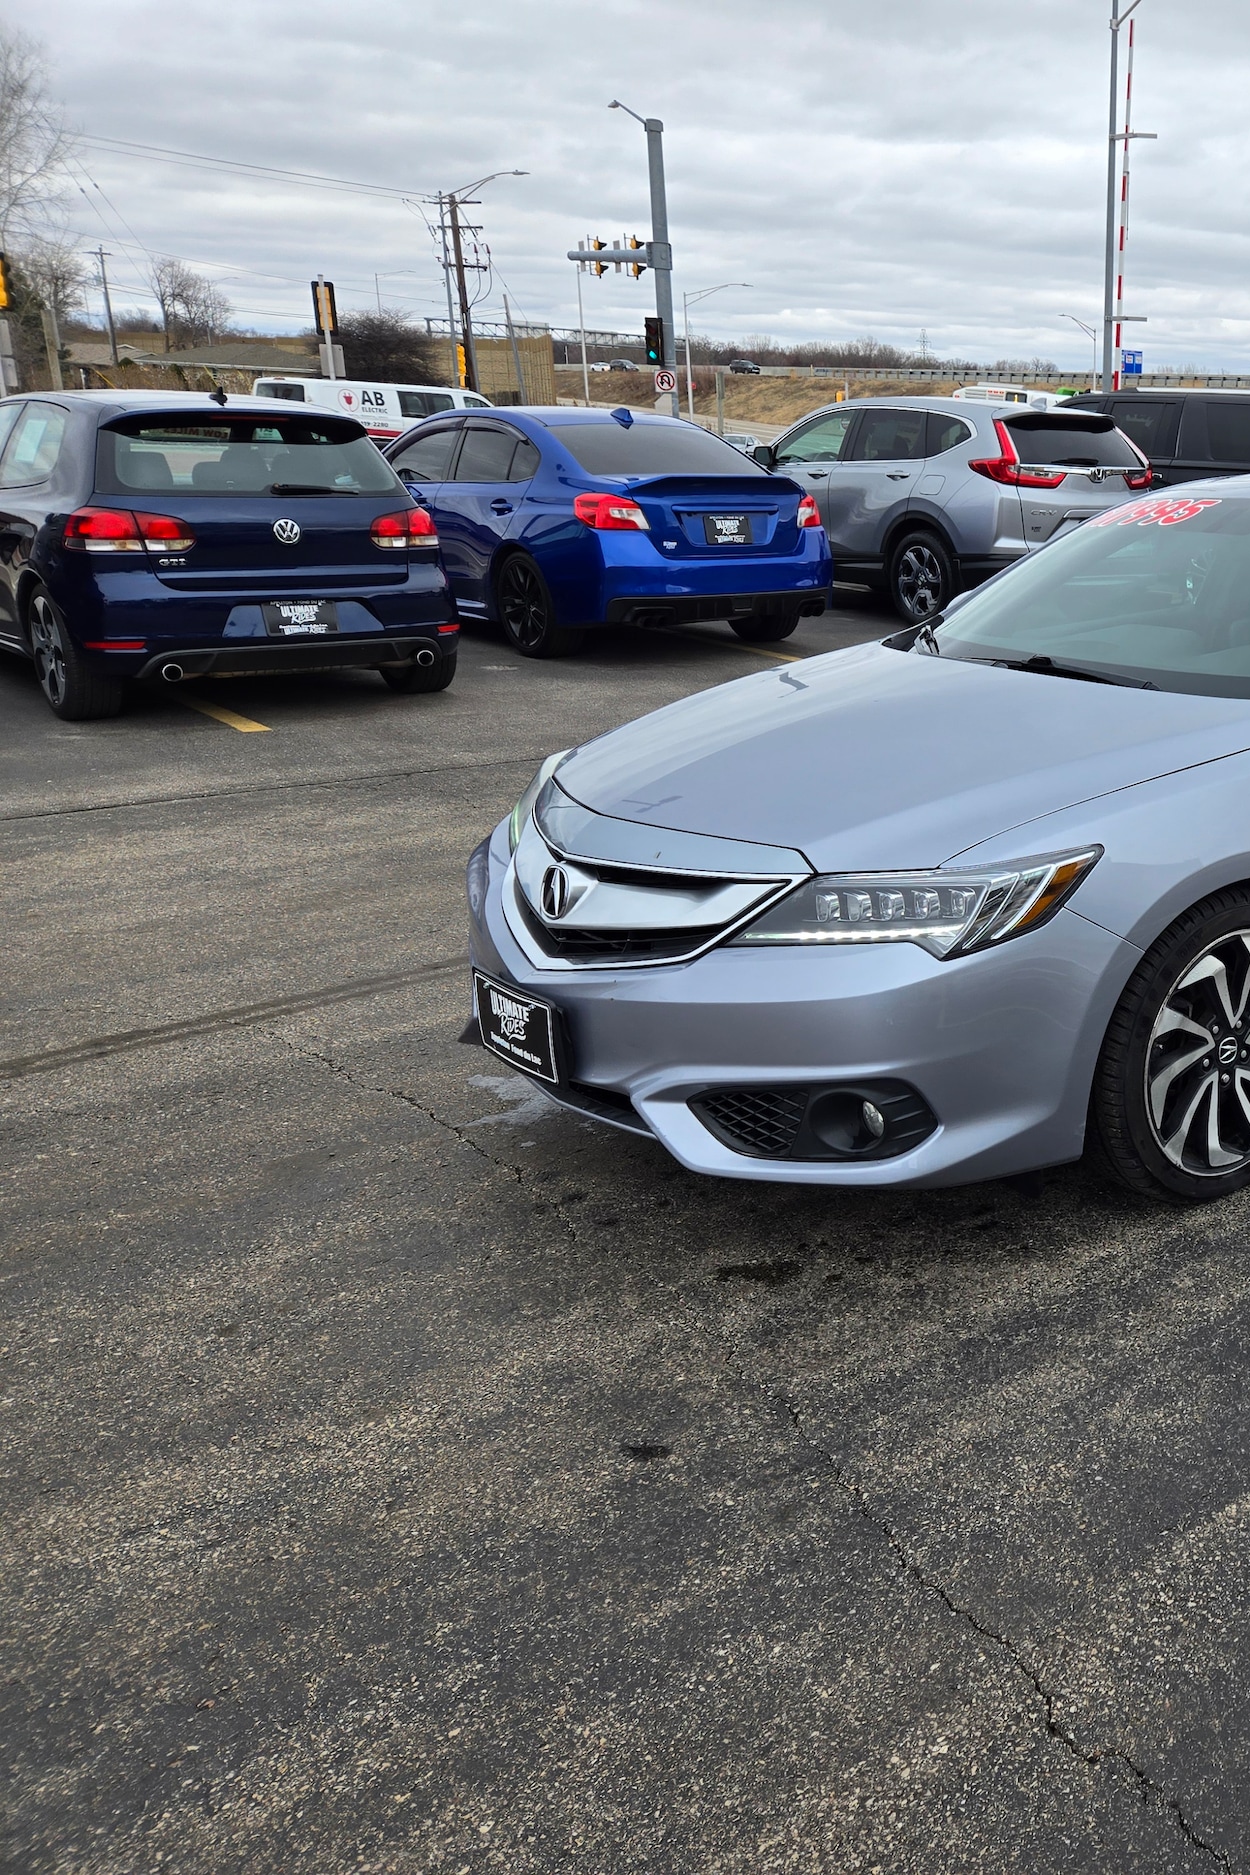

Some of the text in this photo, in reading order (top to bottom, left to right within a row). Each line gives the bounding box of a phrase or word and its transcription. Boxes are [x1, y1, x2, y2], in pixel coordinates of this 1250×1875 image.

[361, 390, 385, 406] AB
[159, 558, 186, 566] GTI
[280, 605, 319, 617] ULTIMATE
[291, 612, 316, 624] RIDES
[489, 989, 530, 1022] ULTIMATE
[499, 1012, 526, 1040] RIDES
